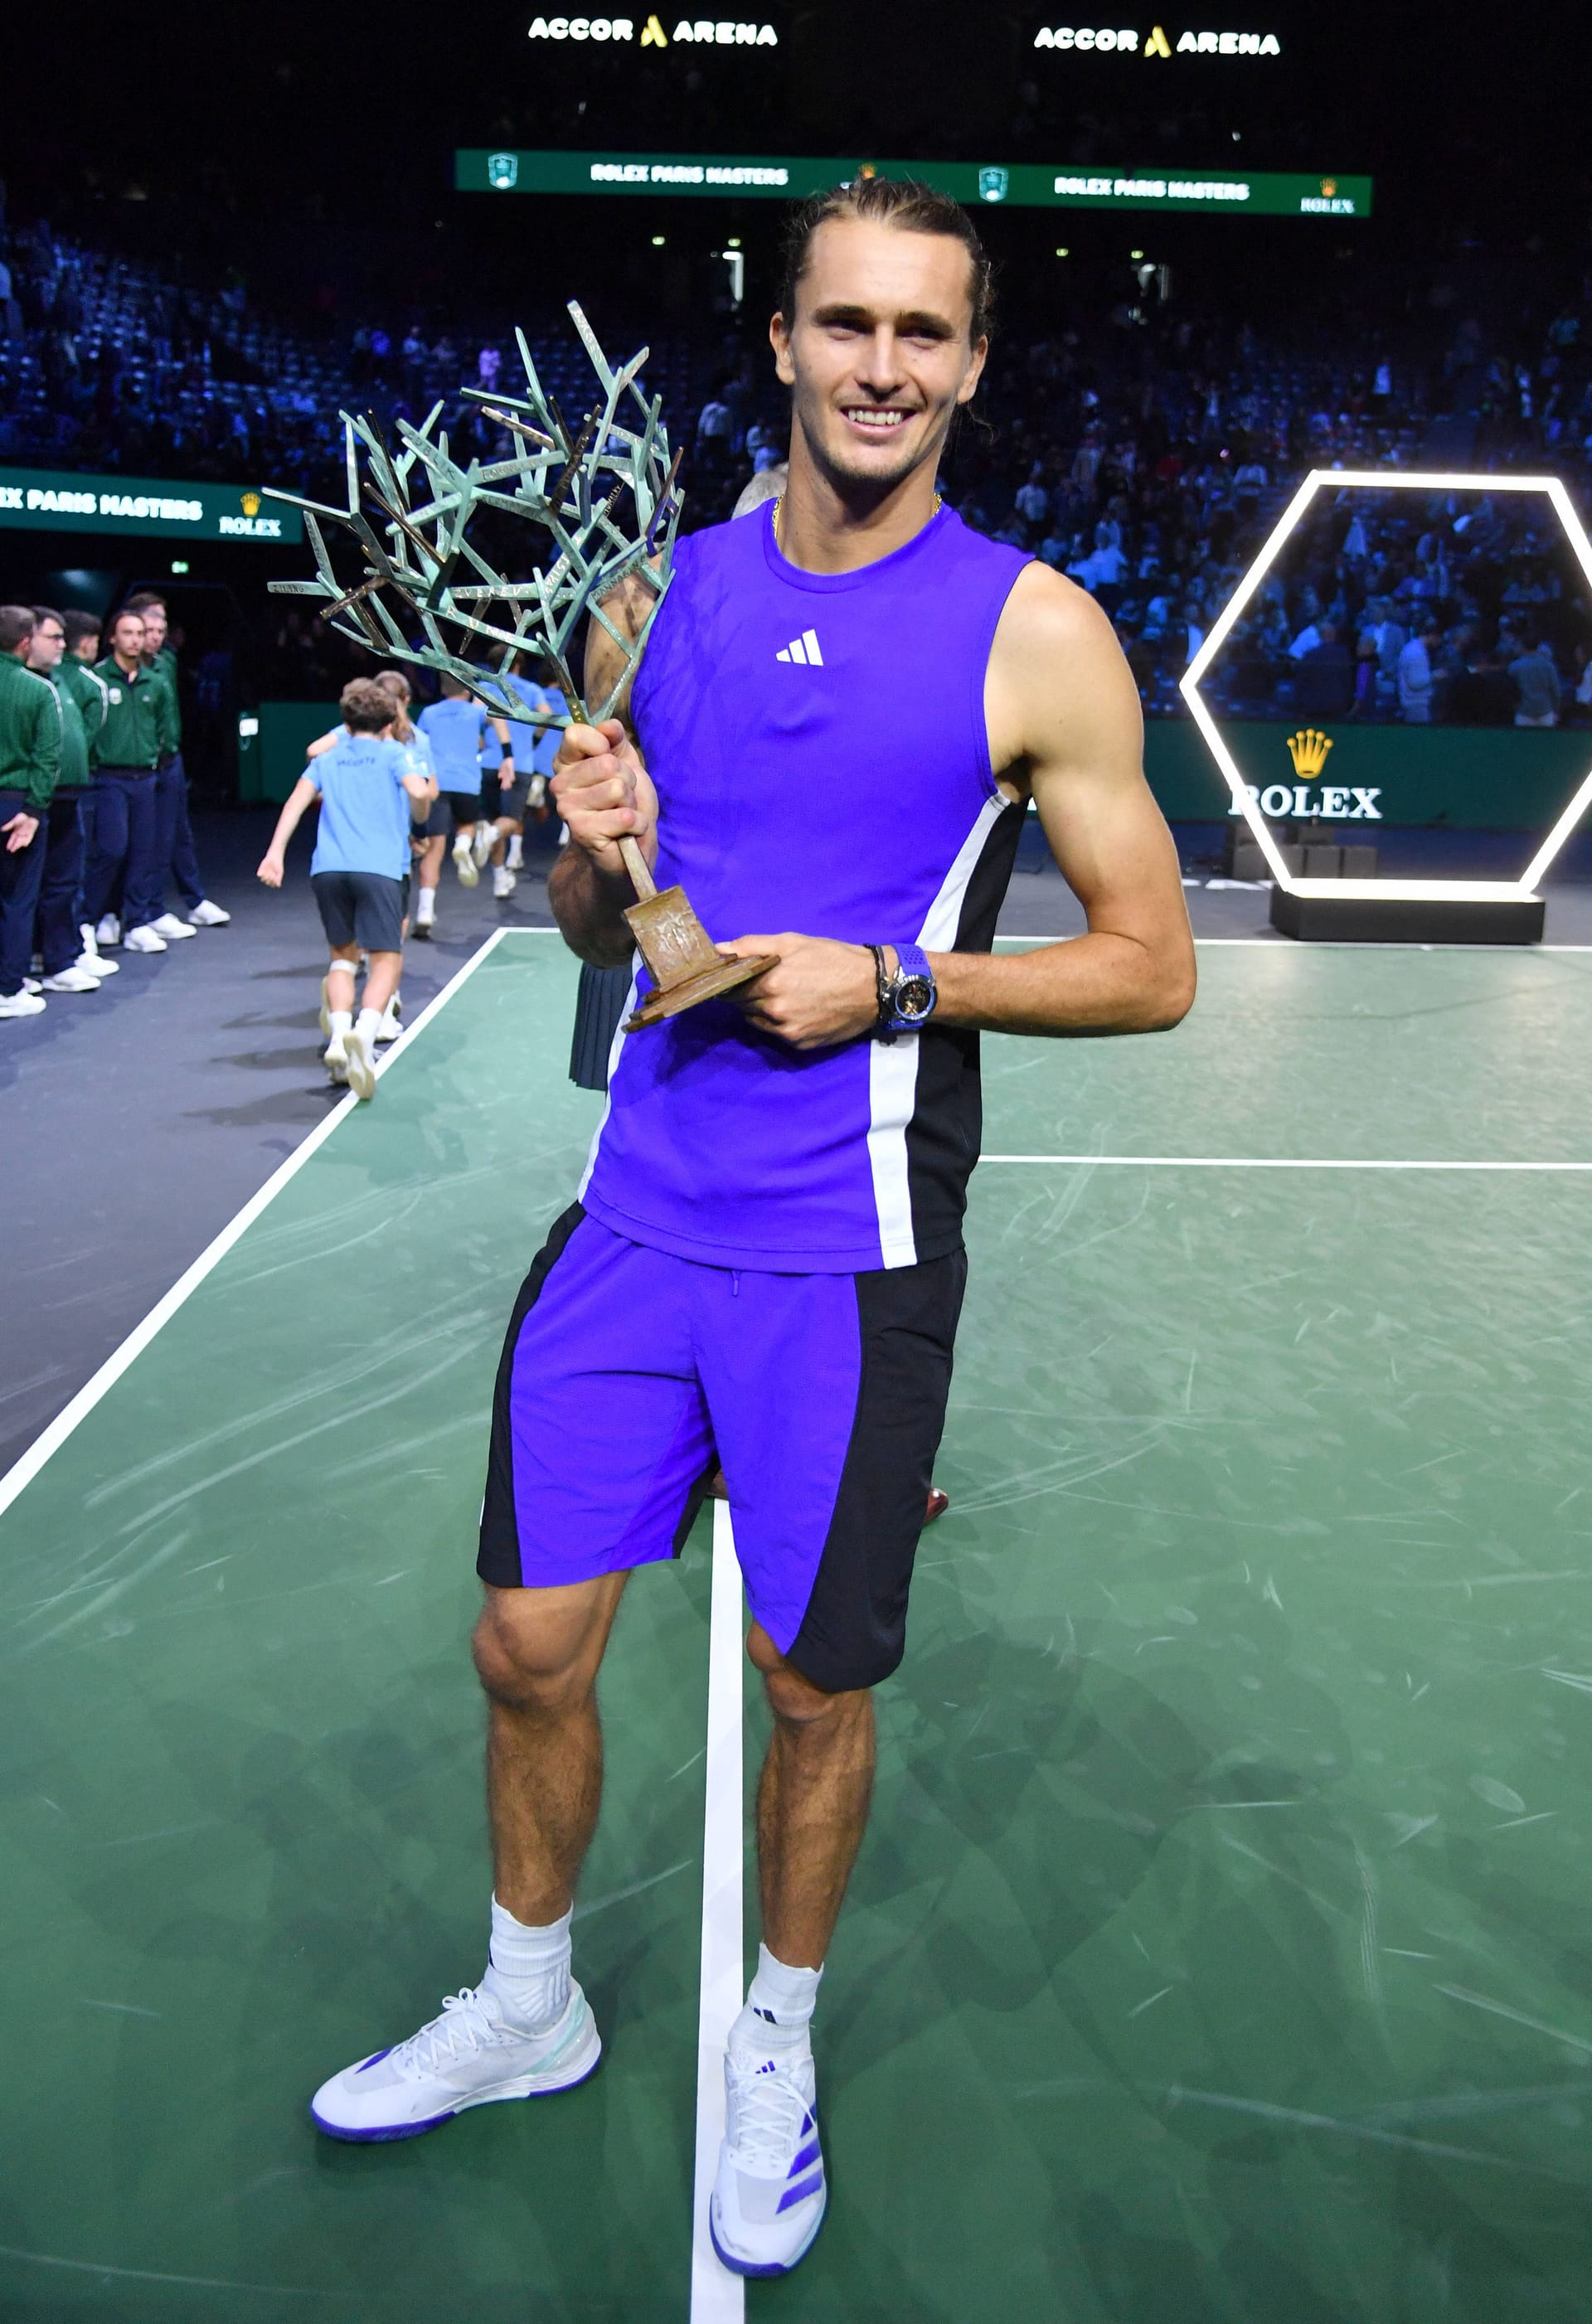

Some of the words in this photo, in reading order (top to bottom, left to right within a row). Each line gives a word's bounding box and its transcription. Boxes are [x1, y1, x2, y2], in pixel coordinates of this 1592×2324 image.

[527, 17, 633, 41] ACCOR
[672, 20, 779, 46] ARENA
[1033, 27, 1138, 51] ACCOR
[1176, 31, 1281, 56] ARENA
[590, 163, 649, 182] ROLEX
[650, 165, 705, 183] PARIS
[706, 167, 789, 186] MASTERS
[1054, 177, 1113, 196] ROLEX
[1114, 178, 1167, 197] PARIS
[1167, 181, 1250, 201] MASTERS
[27, 488, 97, 514] PARIS
[99, 494, 203, 521] MASTERS
[218, 516, 281, 537] ROLEX
[544, 536, 582, 594] TTSIPAS
